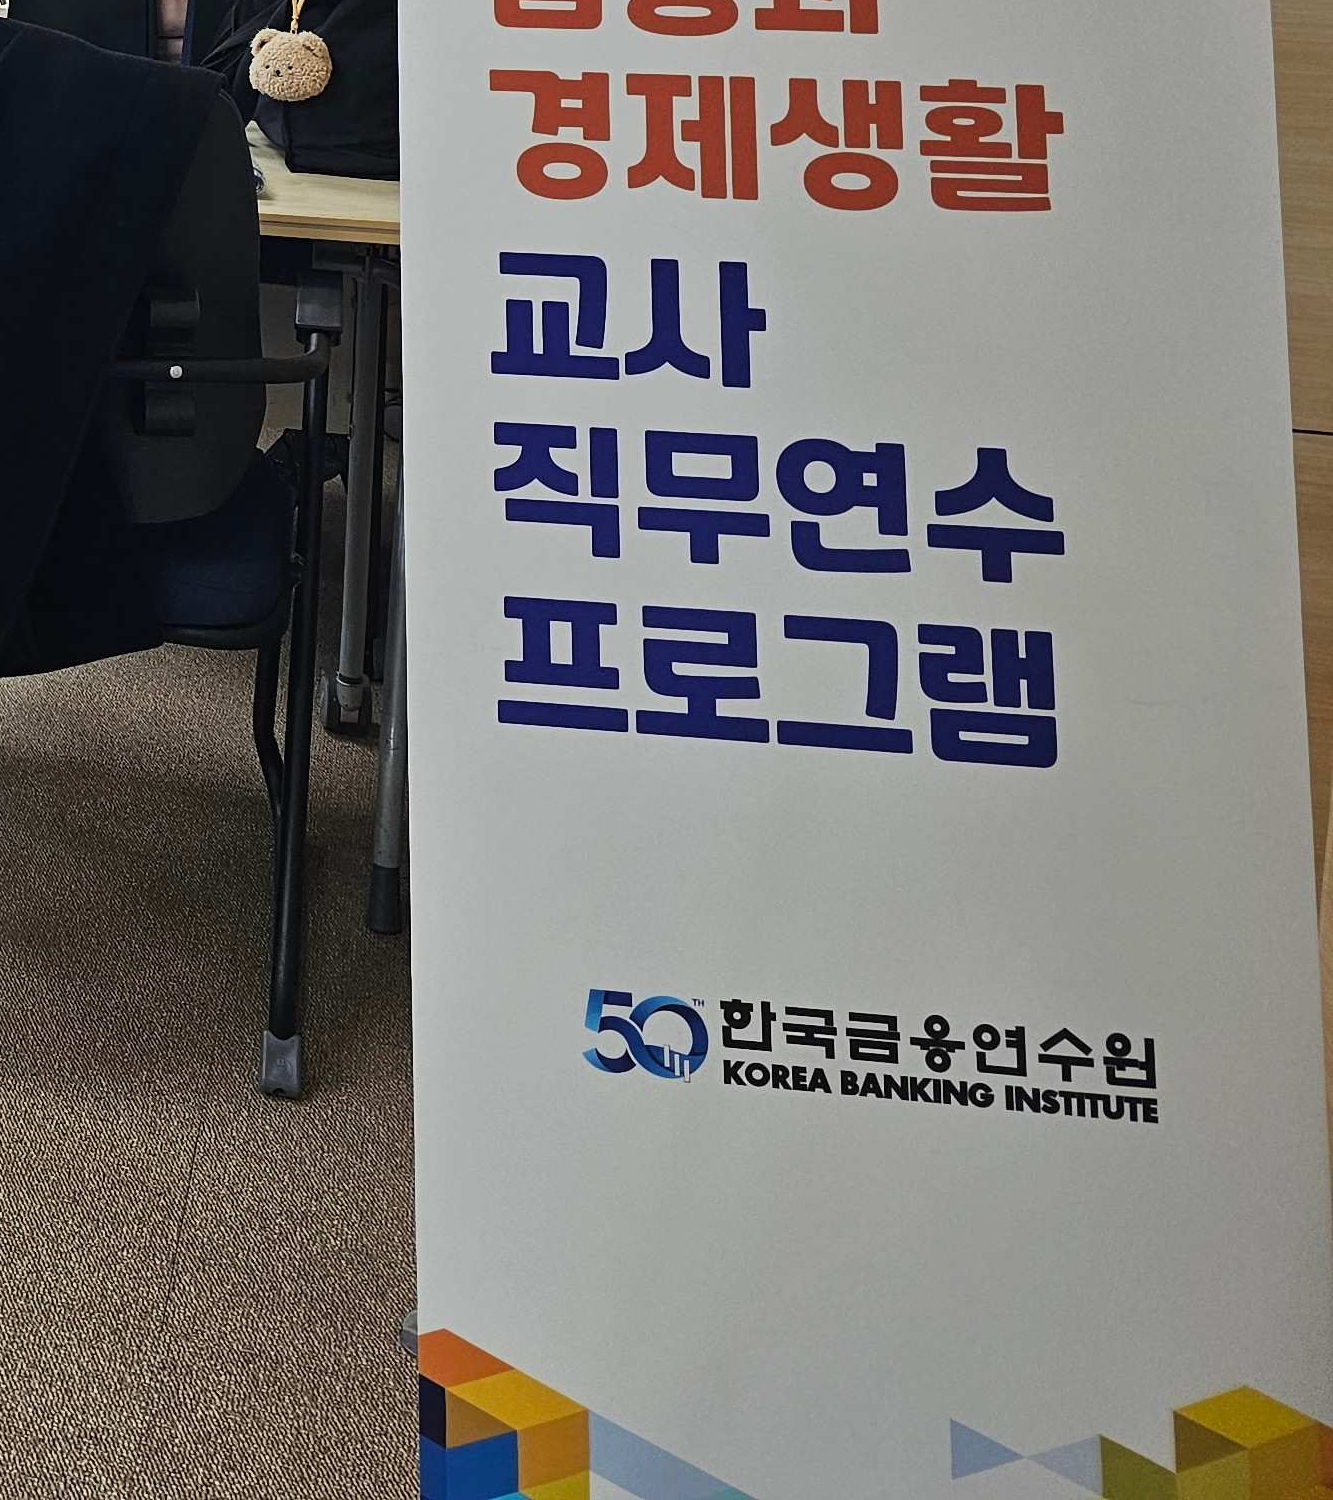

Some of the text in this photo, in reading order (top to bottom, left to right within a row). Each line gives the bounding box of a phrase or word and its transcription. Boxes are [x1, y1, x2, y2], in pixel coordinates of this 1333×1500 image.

[489, 69, 1063, 212] 경제생활
[491, 251, 767, 388] 교사
[494, 421, 1065, 583] 직무연수
[498, 596, 1058, 768] 프로그램
[720, 998, 1157, 1089] 한국금융연수원
[723, 1059, 1159, 1124] KOREA BANKING INSTITUTE
